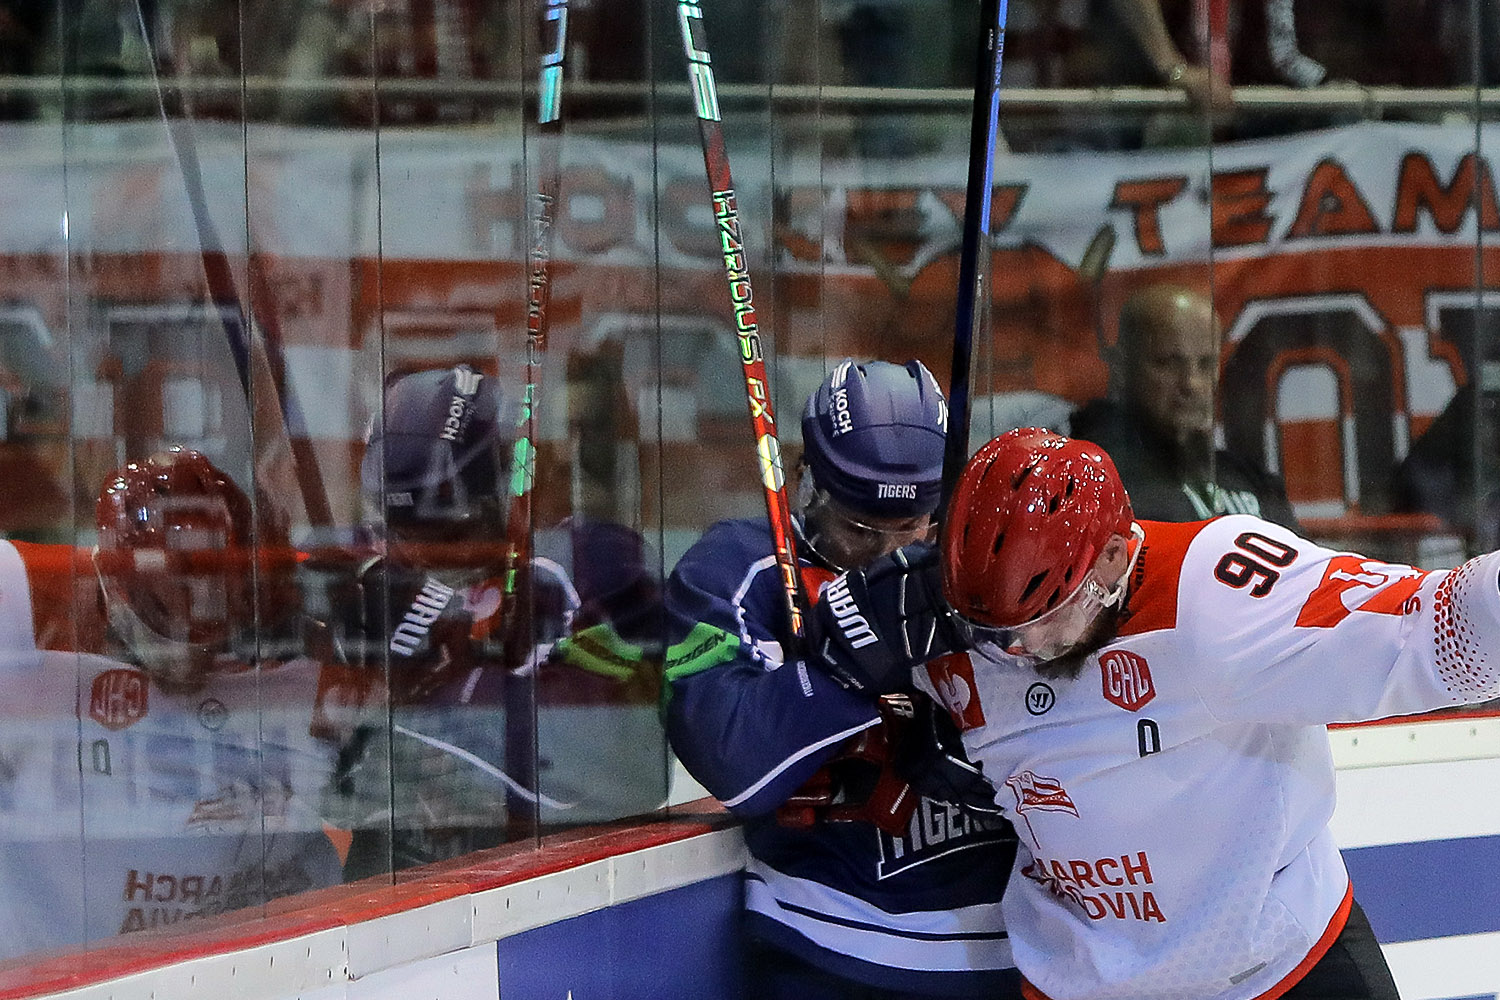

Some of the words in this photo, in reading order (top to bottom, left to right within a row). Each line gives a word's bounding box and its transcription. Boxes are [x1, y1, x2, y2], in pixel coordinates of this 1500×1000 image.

[835, 388, 854, 434] KOCH
[877, 483, 918, 500] TIGERS
[1213, 531, 1299, 599] 90
[1105, 653, 1150, 705] CHL
